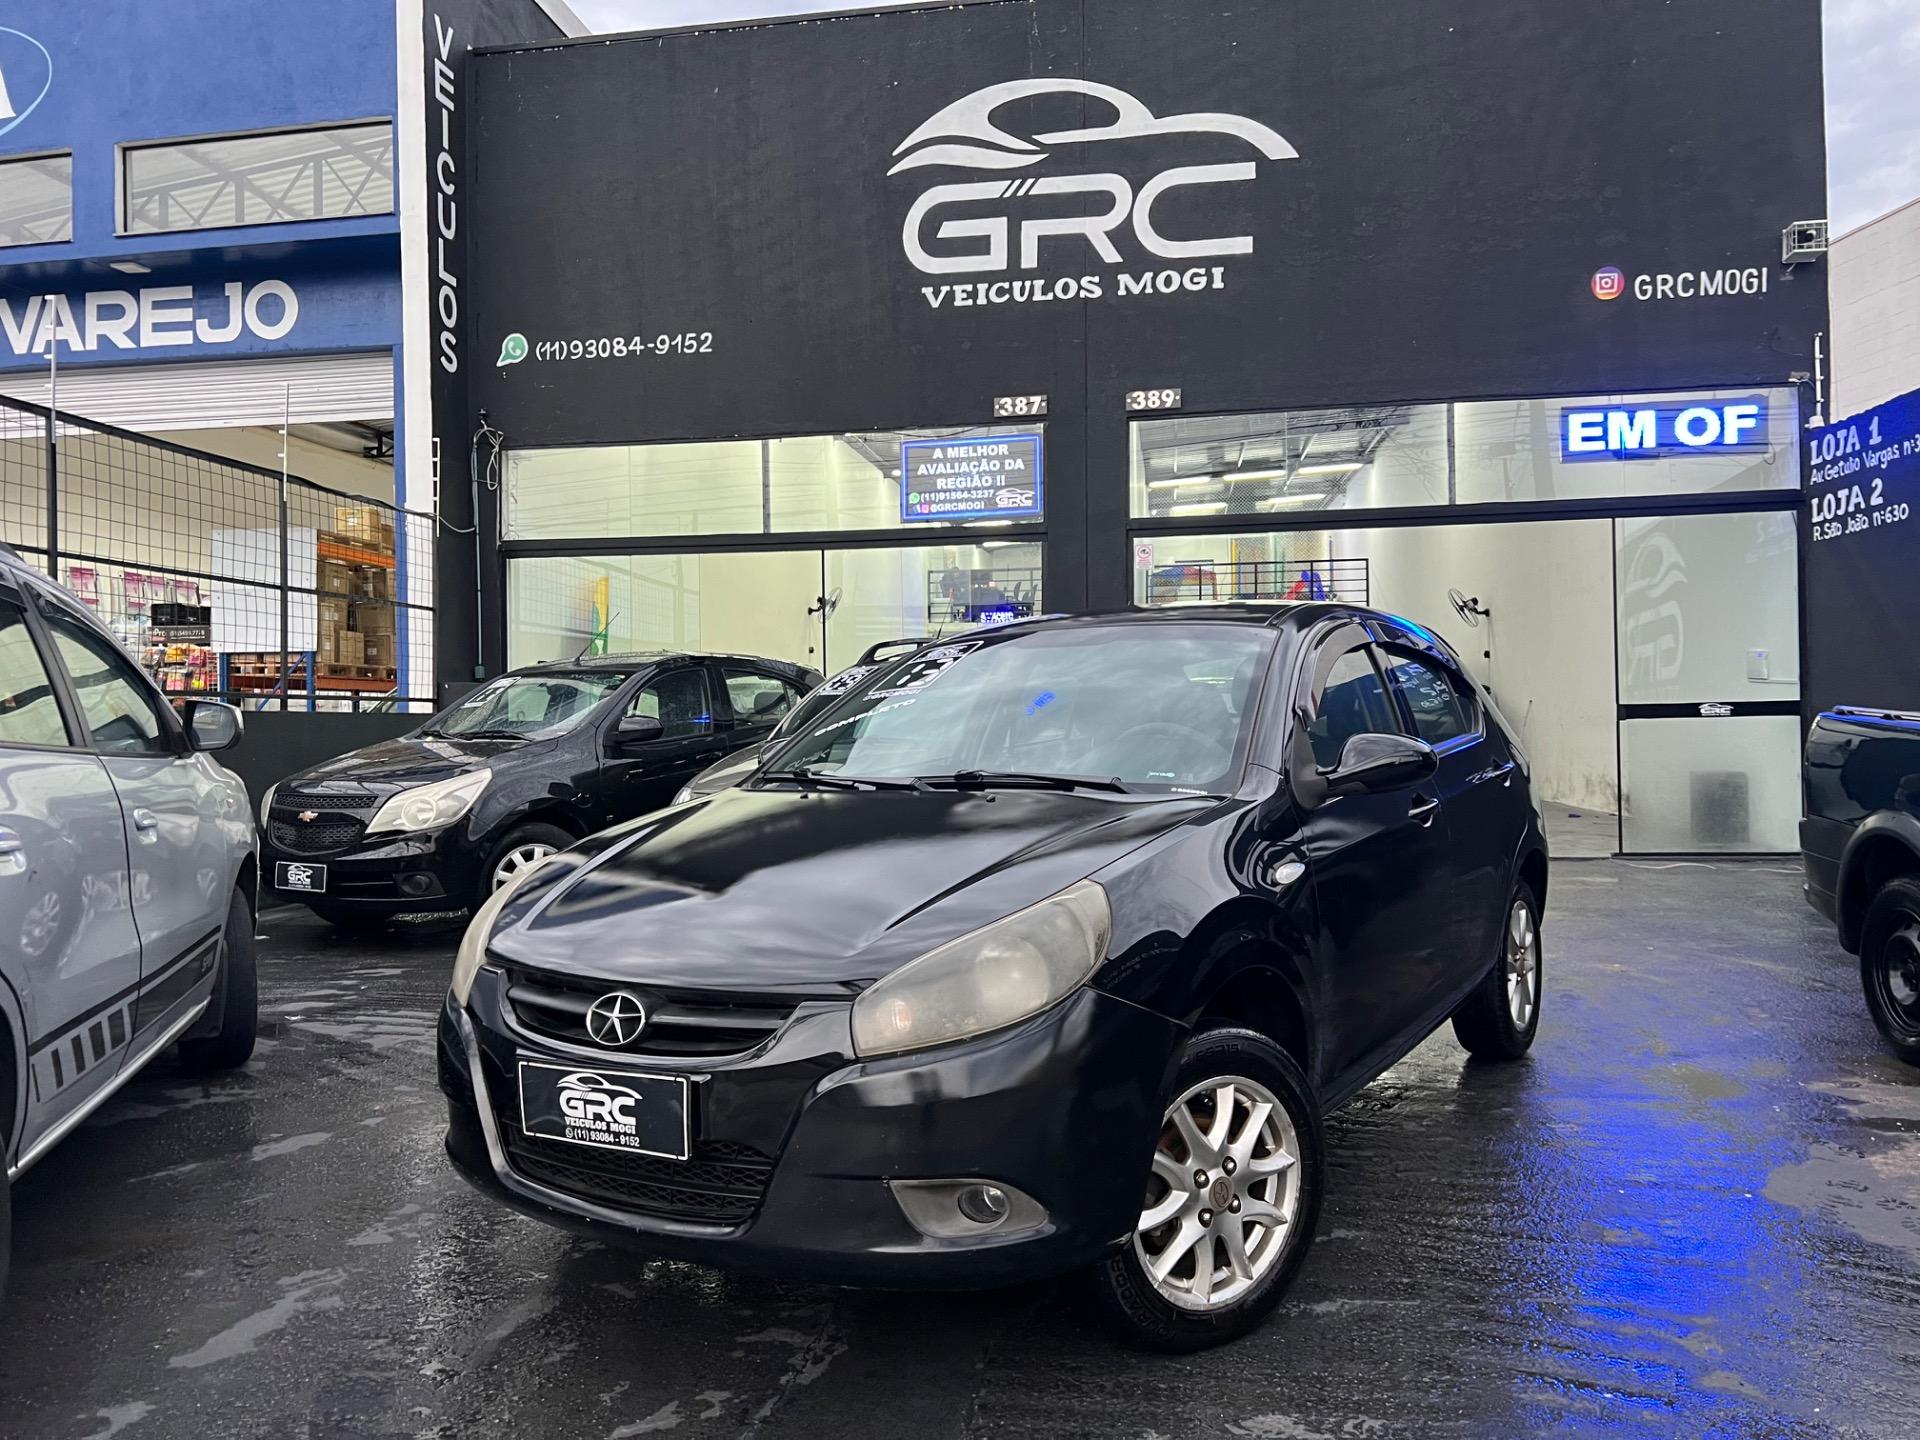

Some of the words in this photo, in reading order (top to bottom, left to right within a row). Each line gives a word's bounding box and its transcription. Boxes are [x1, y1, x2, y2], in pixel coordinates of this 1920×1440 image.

[434, 14, 457, 373] VEICULOS
[902, 161, 1256, 275] GRC
[922, 275, 1102, 309] VEICULOS
[1117, 266, 1225, 297] MOGI
[0, 280, 299, 355] VAREJO
[535, 332, 713, 361] (11)93084-9152
[999, 396, 1042, 416] 387
[1131, 390, 1175, 411] 389
[1567, 409, 1656, 452] EM
[1674, 404, 1760, 447] OF
[1810, 425, 1860, 466] LOJA
[1869, 415, 1882, 446] 1
[932, 448, 944, 459] A
[947, 444, 1009, 459] MELHOR
[917, 460, 1000, 475] AVALIAÇÃO
[1004, 458, 1025, 471] DA
[936, 475, 993, 490] REGIÃO
[996, 493, 1032, 505] GRC
[1811, 485, 1866, 524] LOJA
[1870, 478, 1884, 506] 2
[287, 870, 311, 882] GRC
[559, 1089, 637, 1126] GRC
[564, 1116, 607, 1131] VEICULOS
[610, 1122, 636, 1135] MOGI
[574, 1128, 590, 1142] (11)
[619, 1135, 640, 1147] 9152
